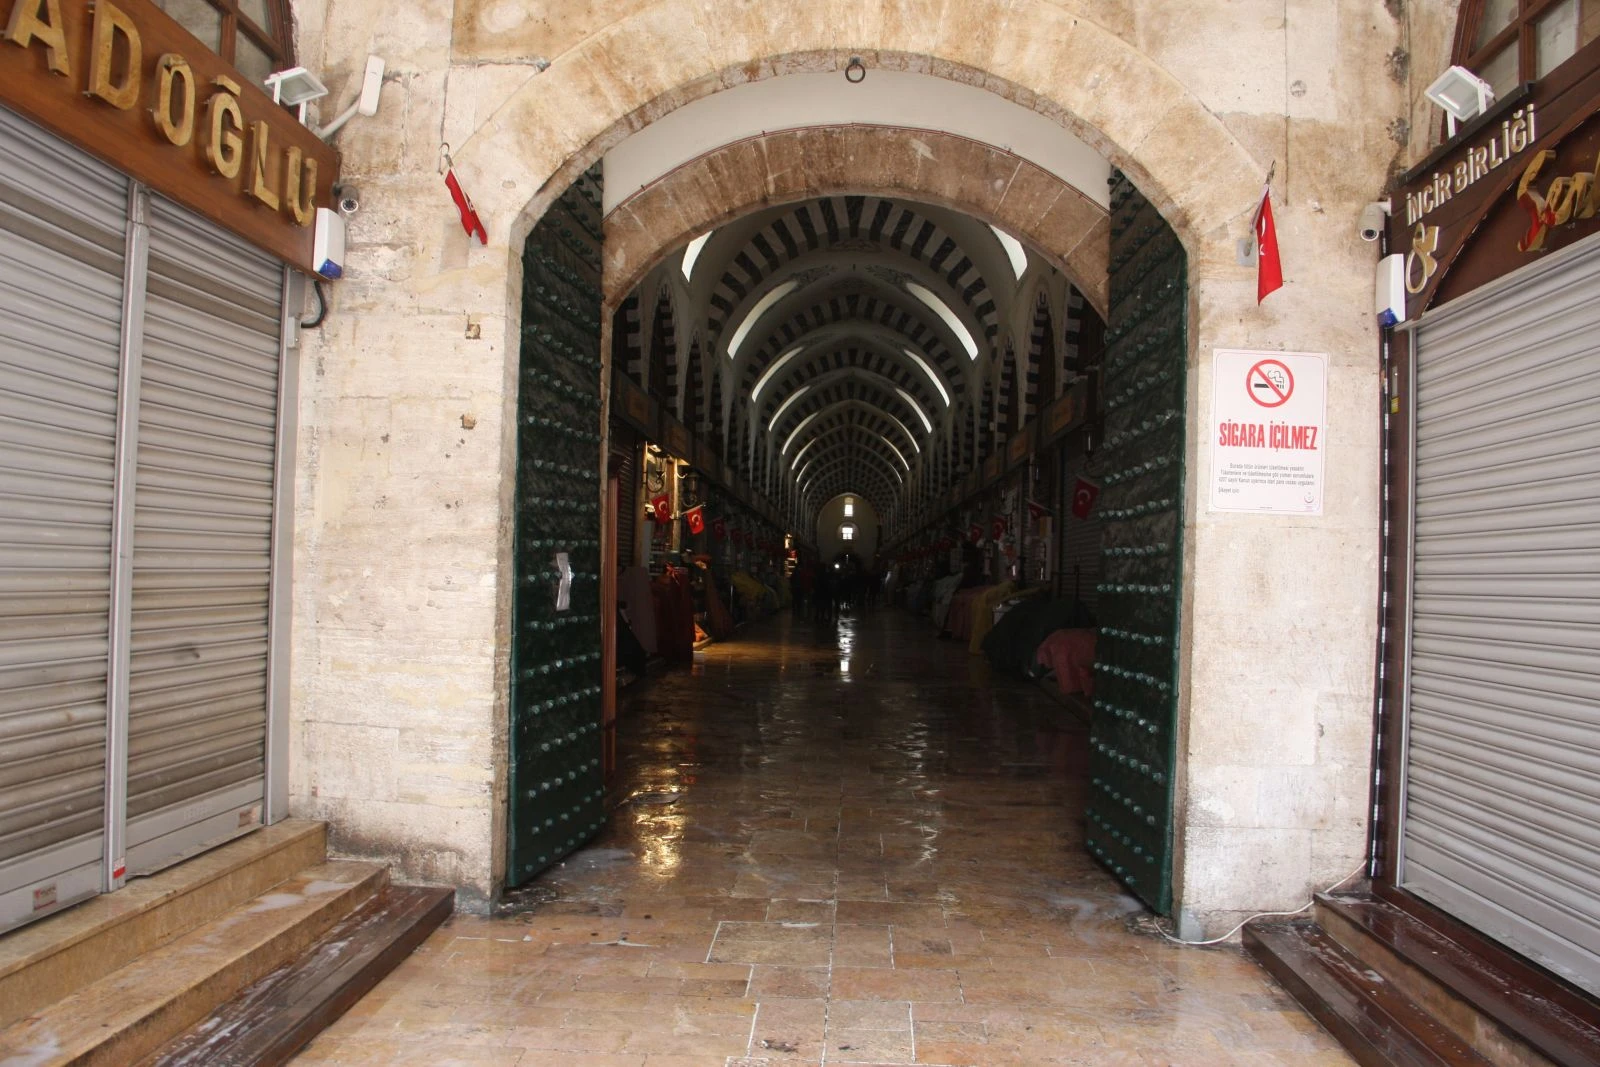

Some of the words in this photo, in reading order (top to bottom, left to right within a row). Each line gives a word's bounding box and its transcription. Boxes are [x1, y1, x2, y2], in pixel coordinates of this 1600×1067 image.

[1406, 172, 1452, 226] İNCİR
[1455, 103, 1535, 194] BİRLİĞİ
[1219, 418, 1266, 448] SİGARA
[1269, 420, 1318, 452] İÇİLMEZ
